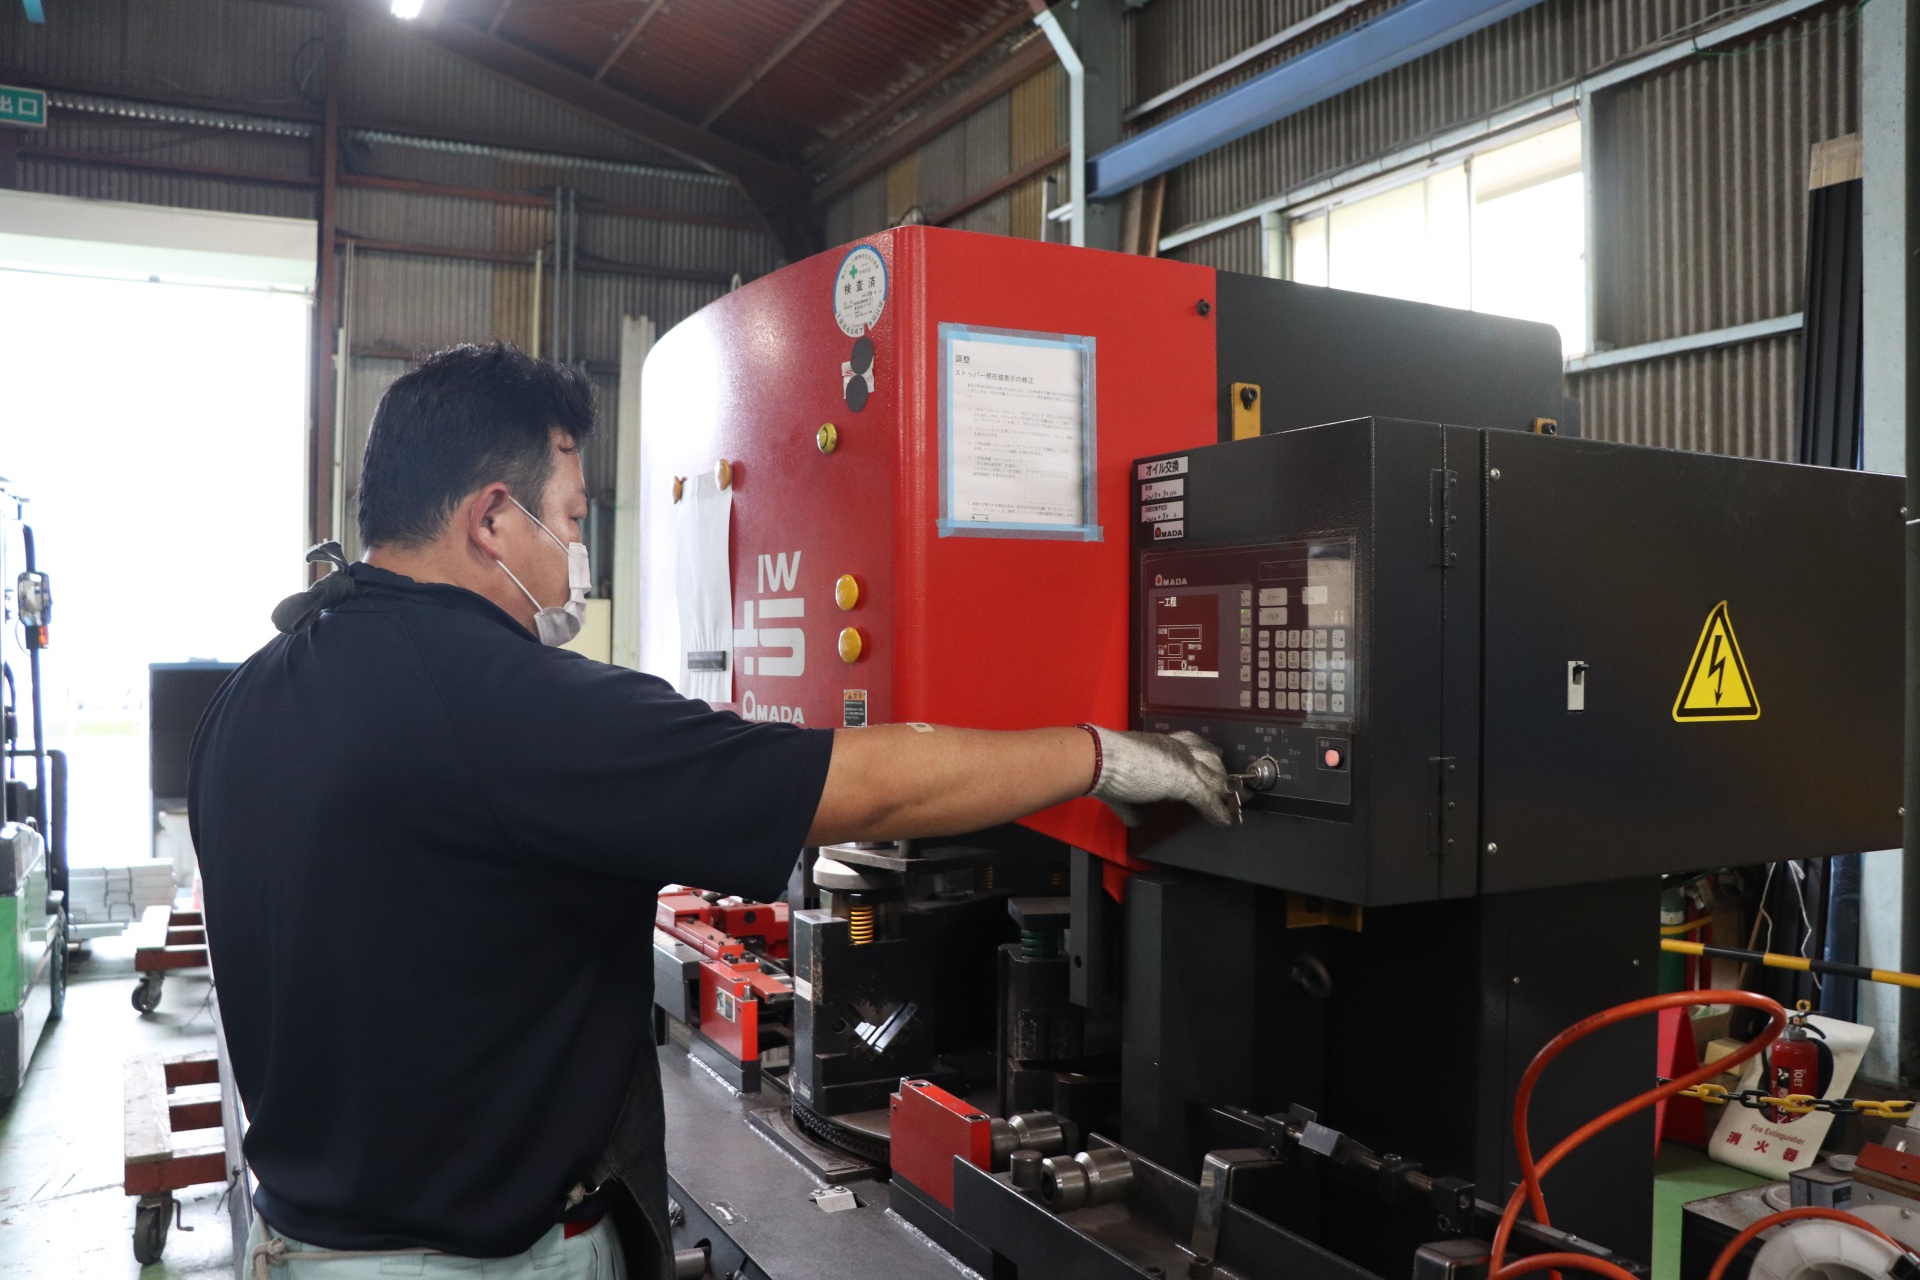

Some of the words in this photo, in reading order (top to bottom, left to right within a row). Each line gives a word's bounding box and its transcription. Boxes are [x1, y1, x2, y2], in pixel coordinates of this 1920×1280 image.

[844, 276, 876, 296] 検査済
[955, 354, 971, 364] 調整
[955, 369, 1035, 385] ストッパー現在値表示の修正
[1146, 459, 1179, 476] オイル交換
[1154, 527, 1183, 538] AMADA
[758, 550, 802, 594] IW
[1155, 574, 1188, 586] AMADA
[1158, 596, 1177, 607] 一工程
[742, 690, 805, 724] AMADA
[1750, 1124, 1763, 1134] Fire
[1764, 1127, 1805, 1145] Extinguisher
[1726, 1131, 1799, 1162] 消火器
